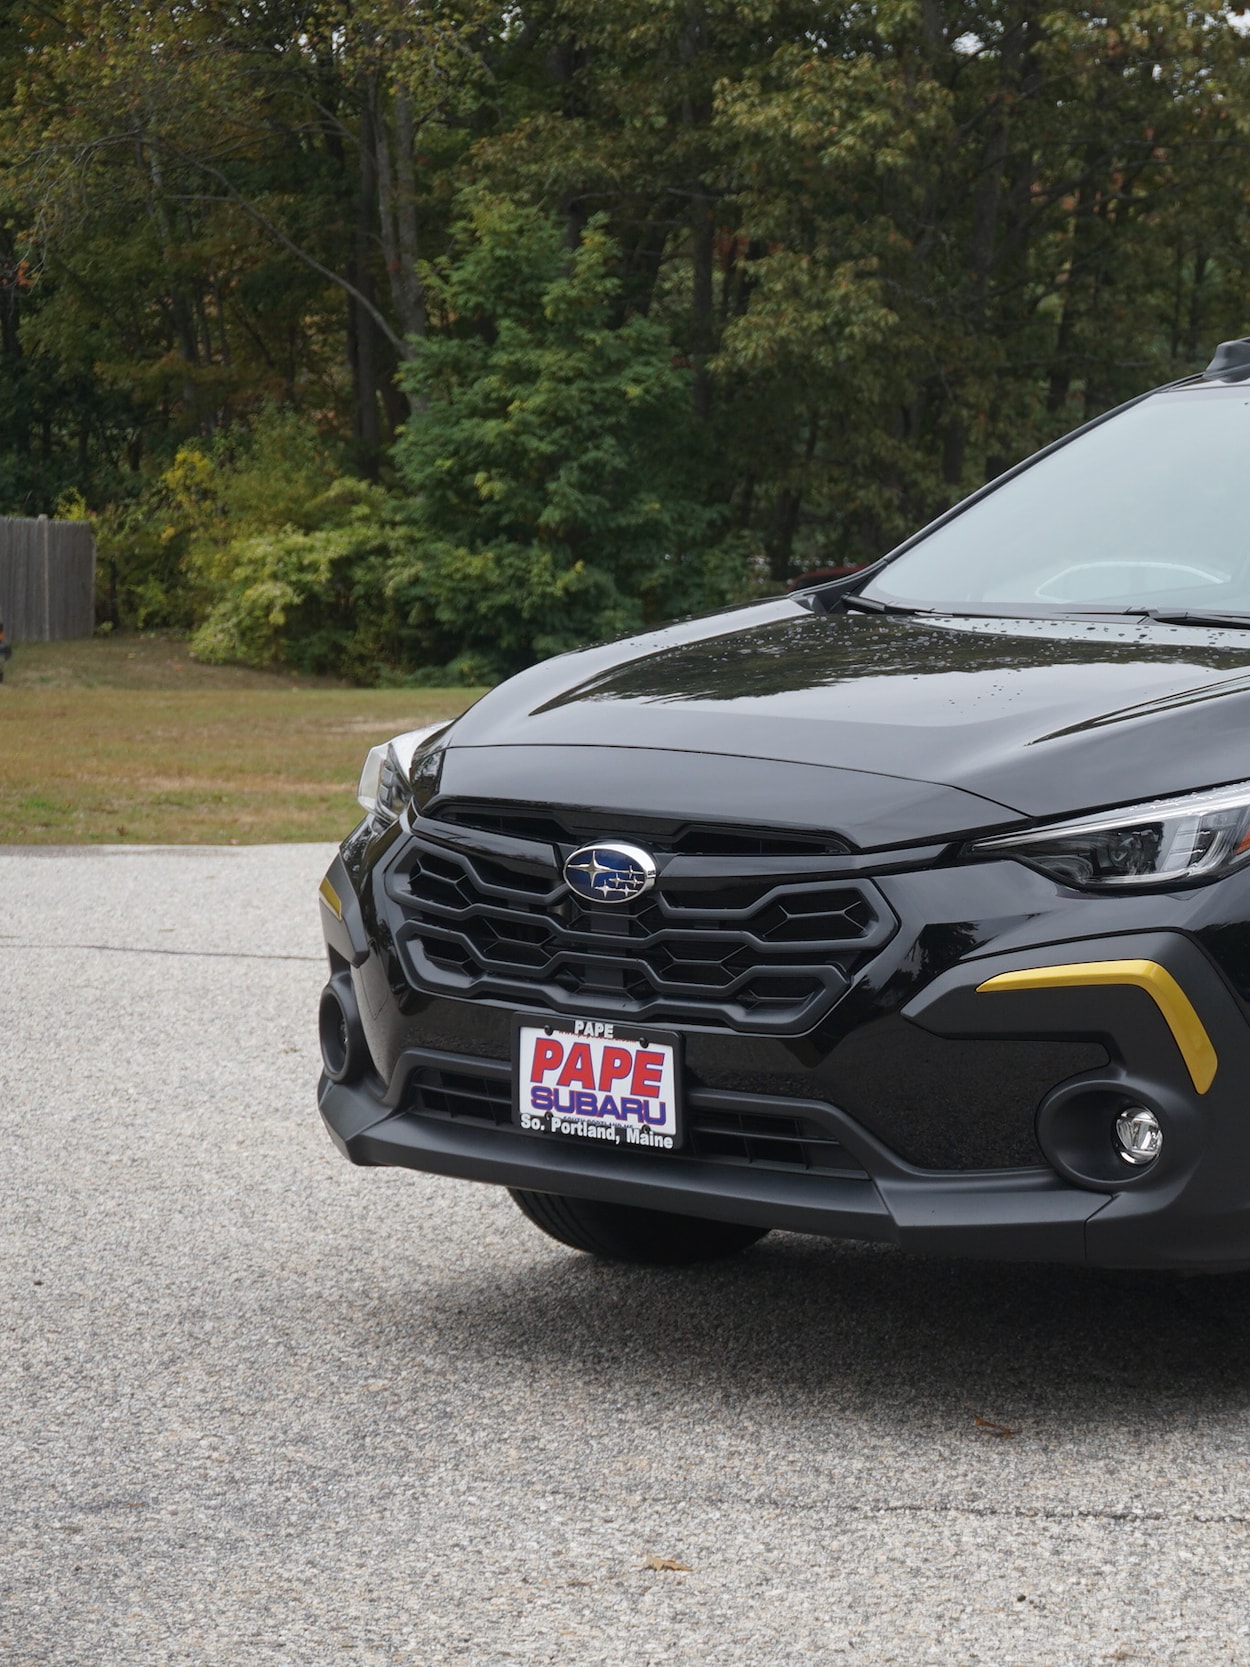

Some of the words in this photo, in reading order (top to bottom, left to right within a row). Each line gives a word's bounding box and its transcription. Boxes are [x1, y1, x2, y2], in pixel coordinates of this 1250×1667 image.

[574, 1020, 614, 1039] PAPE
[530, 1037, 665, 1098] PAPE
[530, 1085, 667, 1126] SUBARU
[520, 1113, 545, 1131] So.
[551, 1117, 621, 1144] Portland,
[626, 1129, 674, 1149] Maine
